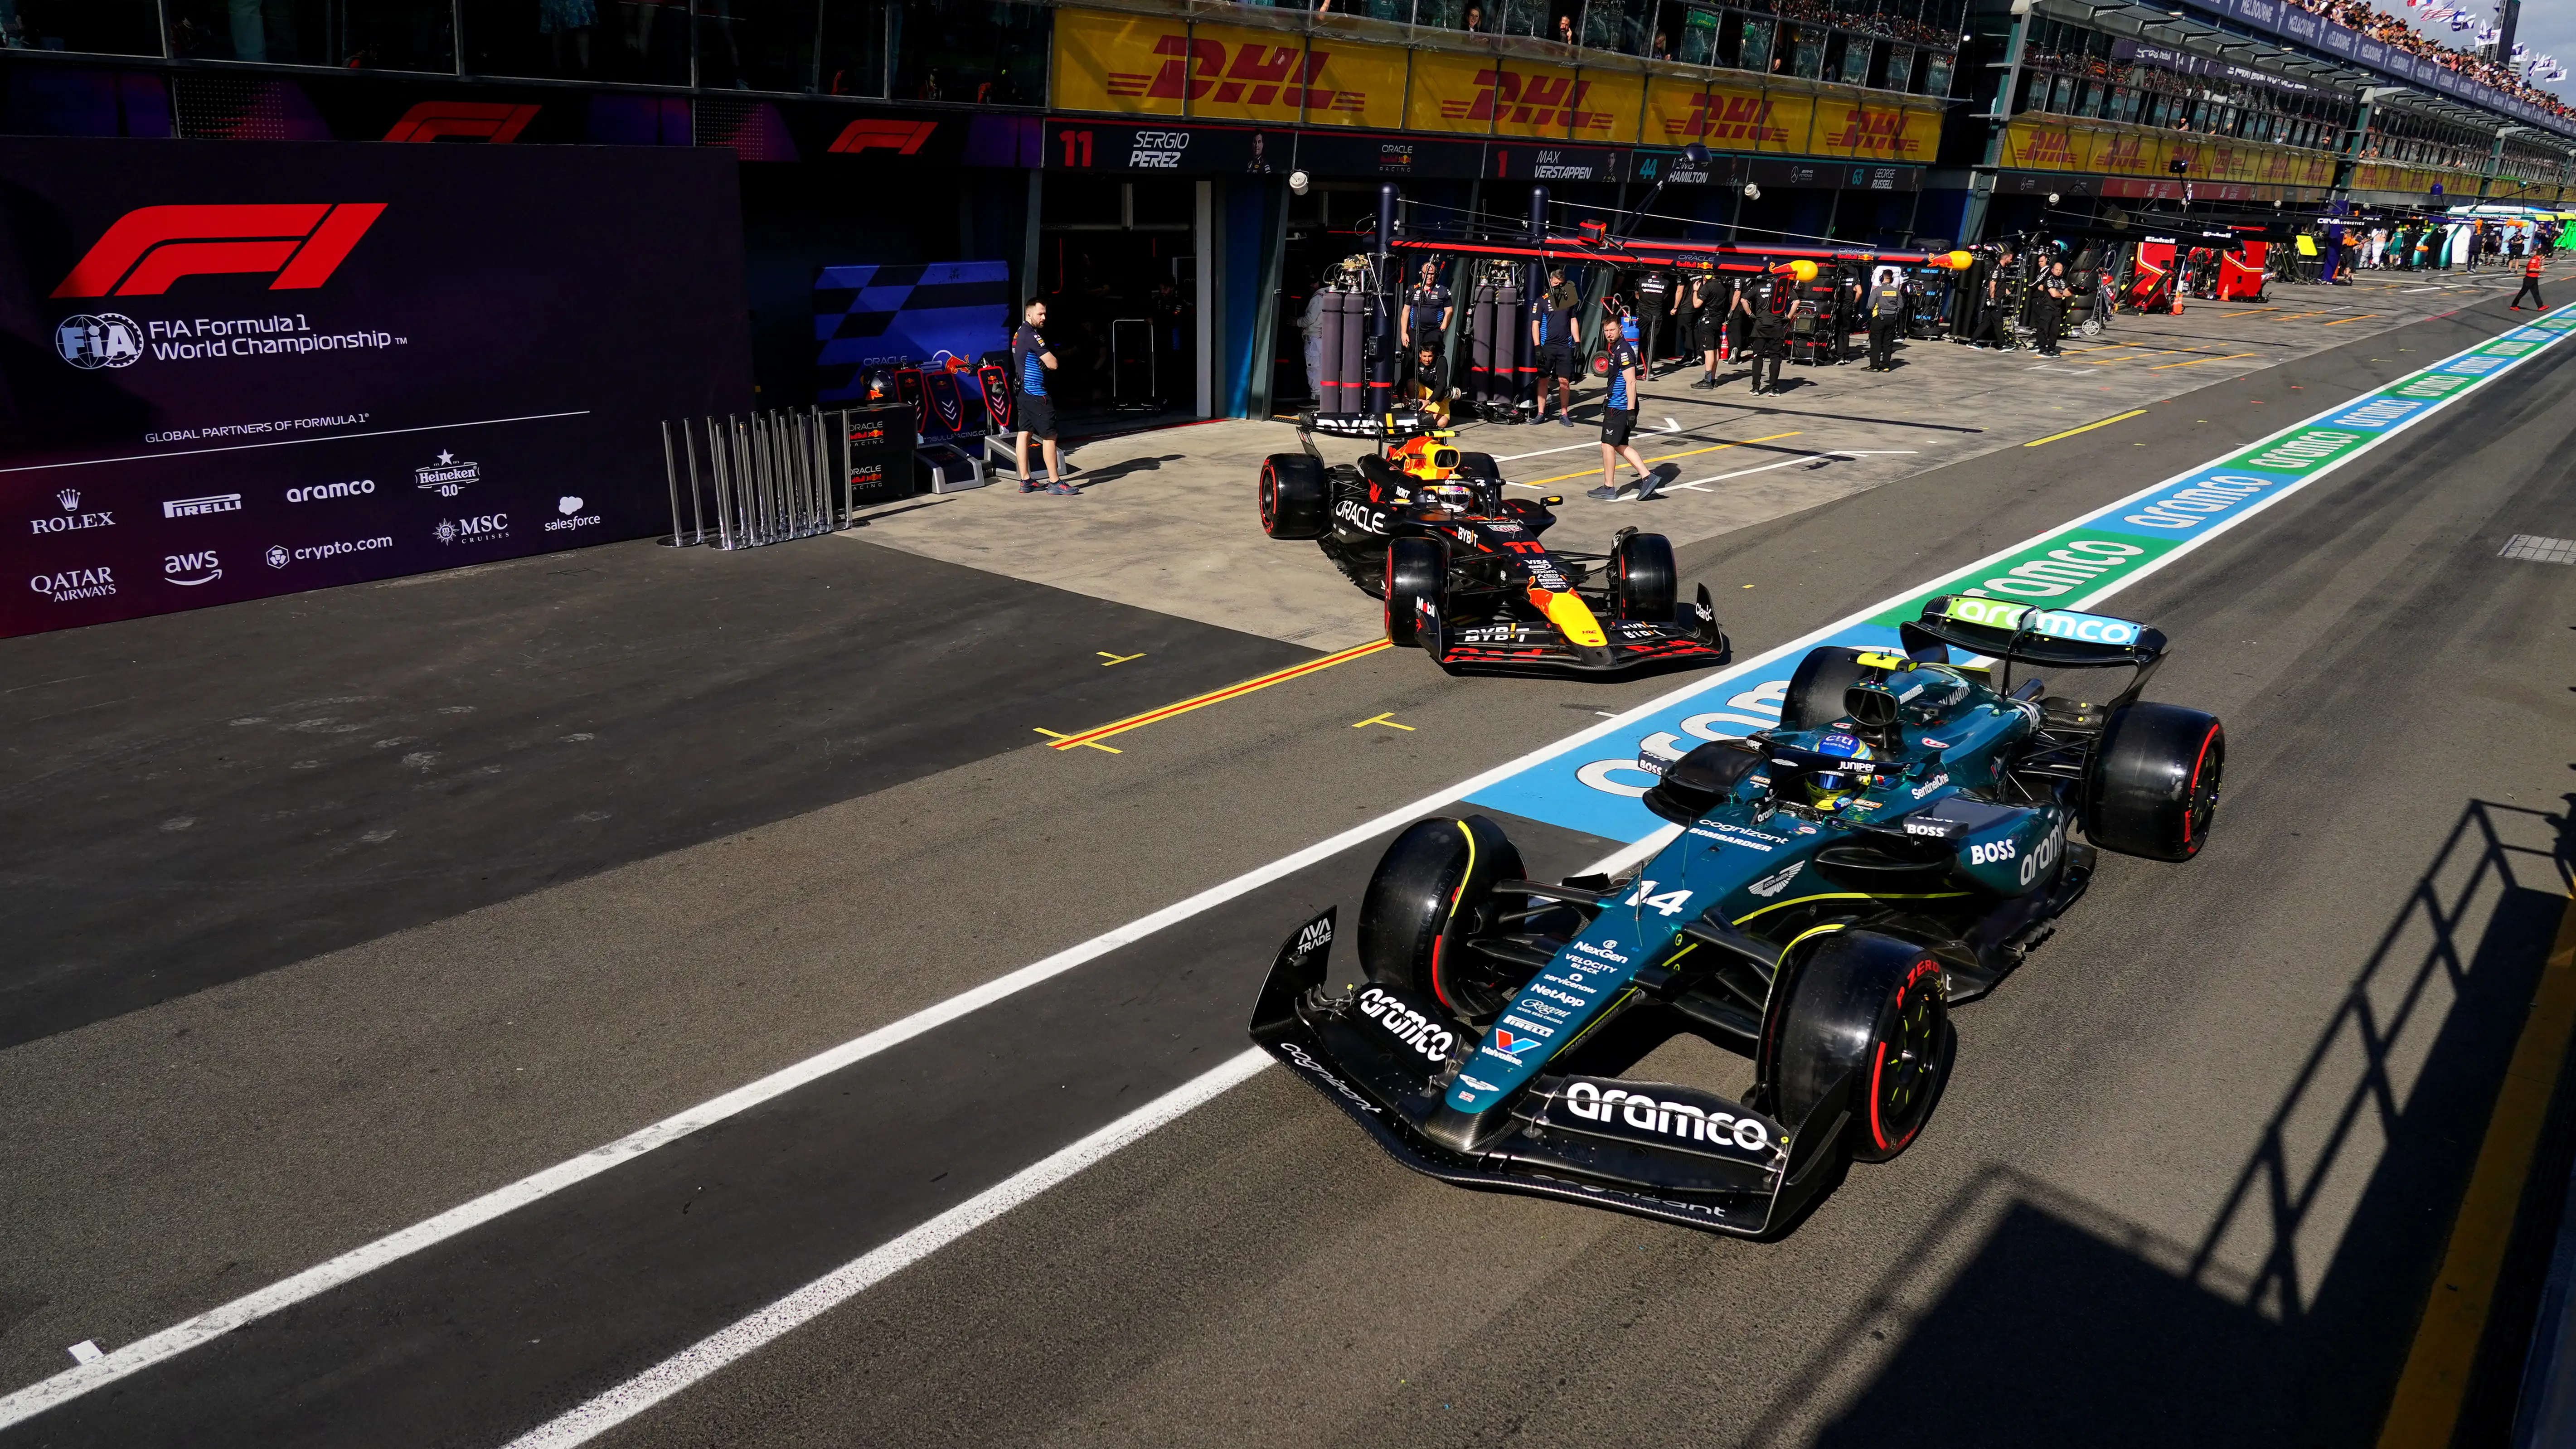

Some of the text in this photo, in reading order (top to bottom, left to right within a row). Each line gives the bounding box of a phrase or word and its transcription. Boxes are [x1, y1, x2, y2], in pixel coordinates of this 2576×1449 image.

[2288, 15, 2316, 38] MELBOURNE
[2327, 30, 2351, 51] MELBOURNE
[1146, 35, 1330, 109] DHL
[1466, 69, 1591, 128] DHL
[1683, 93, 1774, 141] DHL
[1133, 131, 1189, 149] SERGIO
[1839, 111, 1909, 150] DHL
[1059, 131, 1093, 167] 11
[1382, 145, 1413, 154] ORACLE
[1537, 150, 1561, 163] MAX
[2024, 131, 2071, 163] DHL
[2103, 139, 2142, 168] DHL
[1129, 151, 1181, 168] PEREZ
[1497, 151, 1508, 178] 1
[1640, 158, 1656, 179] 44
[1534, 165, 1592, 179] VERSTAPPEN
[1669, 171, 1708, 184] HAMILTON
[1852, 169, 1863, 184] 63
[1875, 169, 1896, 179] GEORGE
[1871, 179, 1893, 189] RUSSELL
[1678, 254, 1716, 262] ORACLE
[150, 314, 310, 339] FIA Formula 1
[151, 339, 226, 361] World
[232, 330, 391, 357] Championship
[864, 355, 907, 366] ORACLE
[2445, 356, 2507, 373] aramco
[2397, 375, 2470, 397] aramco
[2333, 399, 2423, 427] aramco
[146, 430, 199, 444] GLOBAL
[203, 422, 272, 438] PARTNERS
[275, 421, 292, 432] OF
[295, 415, 357, 430] FORMULA
[2248, 431, 2361, 469] aramco
[286, 480, 375, 503] aramco
[441, 484, 459, 497] 0.0
[1396, 486, 1410, 499] ROKT
[2124, 475, 2273, 528] aramco
[163, 493, 242, 518] PIRELLI
[30, 511, 116, 534] ROLEX
[460, 513, 508, 535] MSC
[545, 514, 601, 533] salesforce
[1336, 500, 1390, 535] ORACLE
[461, 532, 510, 544] CRUISES
[1457, 526, 1478, 547] BYBIT
[1502, 541, 1545, 553] 11
[295, 534, 393, 562] crypto.com
[165, 550, 218, 574] aws
[31, 567, 114, 594] QATAR
[53, 584, 116, 602] AIRWAYS
[1416, 596, 1435, 617] Mobil
[1696, 603, 1712, 621] Claro
[1465, 623, 1529, 642] BYBIT
[1957, 601, 2131, 644] aramco
[1898, 684, 1925, 705] BOMBARDIER
[1949, 685, 1971, 706] MARTIN
[1825, 734, 1853, 746] citi
[1640, 760, 1663, 776] BOSS
[1911, 773, 1949, 800] SentinelOne
[1689, 828, 1773, 852] BOMBARDIER
[1699, 819, 1789, 844] cognizant
[1907, 824, 1944, 837] BOSS
[1970, 839, 2016, 865] BOSS
[1625, 880, 1694, 916] 14
[1299, 918, 1331, 945] AVA
[1298, 935, 1331, 955] TRADE
[1573, 941, 1628, 964] NexGen
[1565, 954, 1618, 974] VELOCITY
[1570, 963, 1600, 975] BLACK
[1907, 960, 1940, 989] ZERO
[1543, 973, 1597, 994] servicenow
[1530, 983, 1585, 1009] NetApp
[1521, 998, 1571, 1018] Regent
[1360, 989, 1453, 1061] aramco
[1503, 1015, 1554, 1038] PIRELLI
[1543, 1014, 1563, 1025] CRUISES
[1481, 1046, 1523, 1068] Valvoline
[1281, 1043, 1382, 1114] cognizant
[1567, 1082, 1767, 1151] aramco
